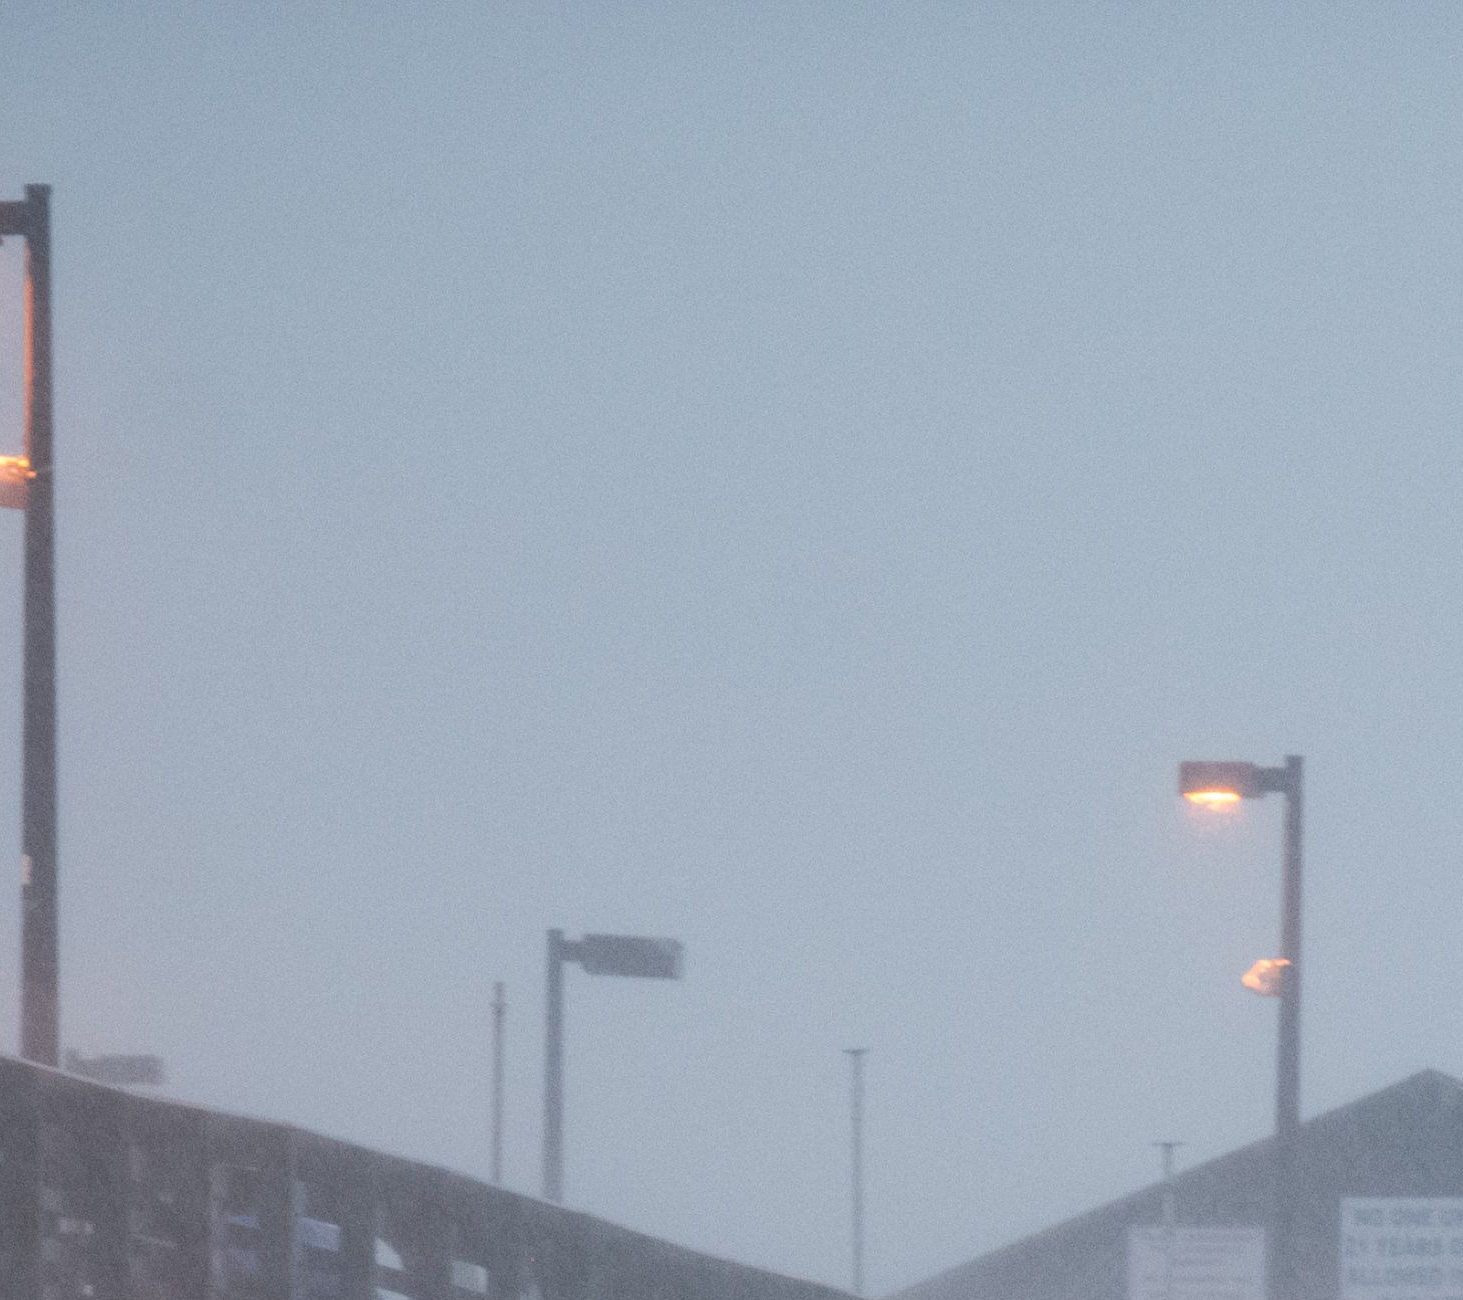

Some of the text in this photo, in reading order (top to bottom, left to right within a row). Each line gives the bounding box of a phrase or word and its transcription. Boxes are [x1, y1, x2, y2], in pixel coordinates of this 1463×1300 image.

[1354, 1208, 1384, 1227] NO
[1390, 1208, 1433, 1227] ONE
[1344, 1236, 1369, 1256] 21
[1376, 1236, 1444, 1257] YEARS
[1347, 1267, 1444, 1287] ALLOWED
